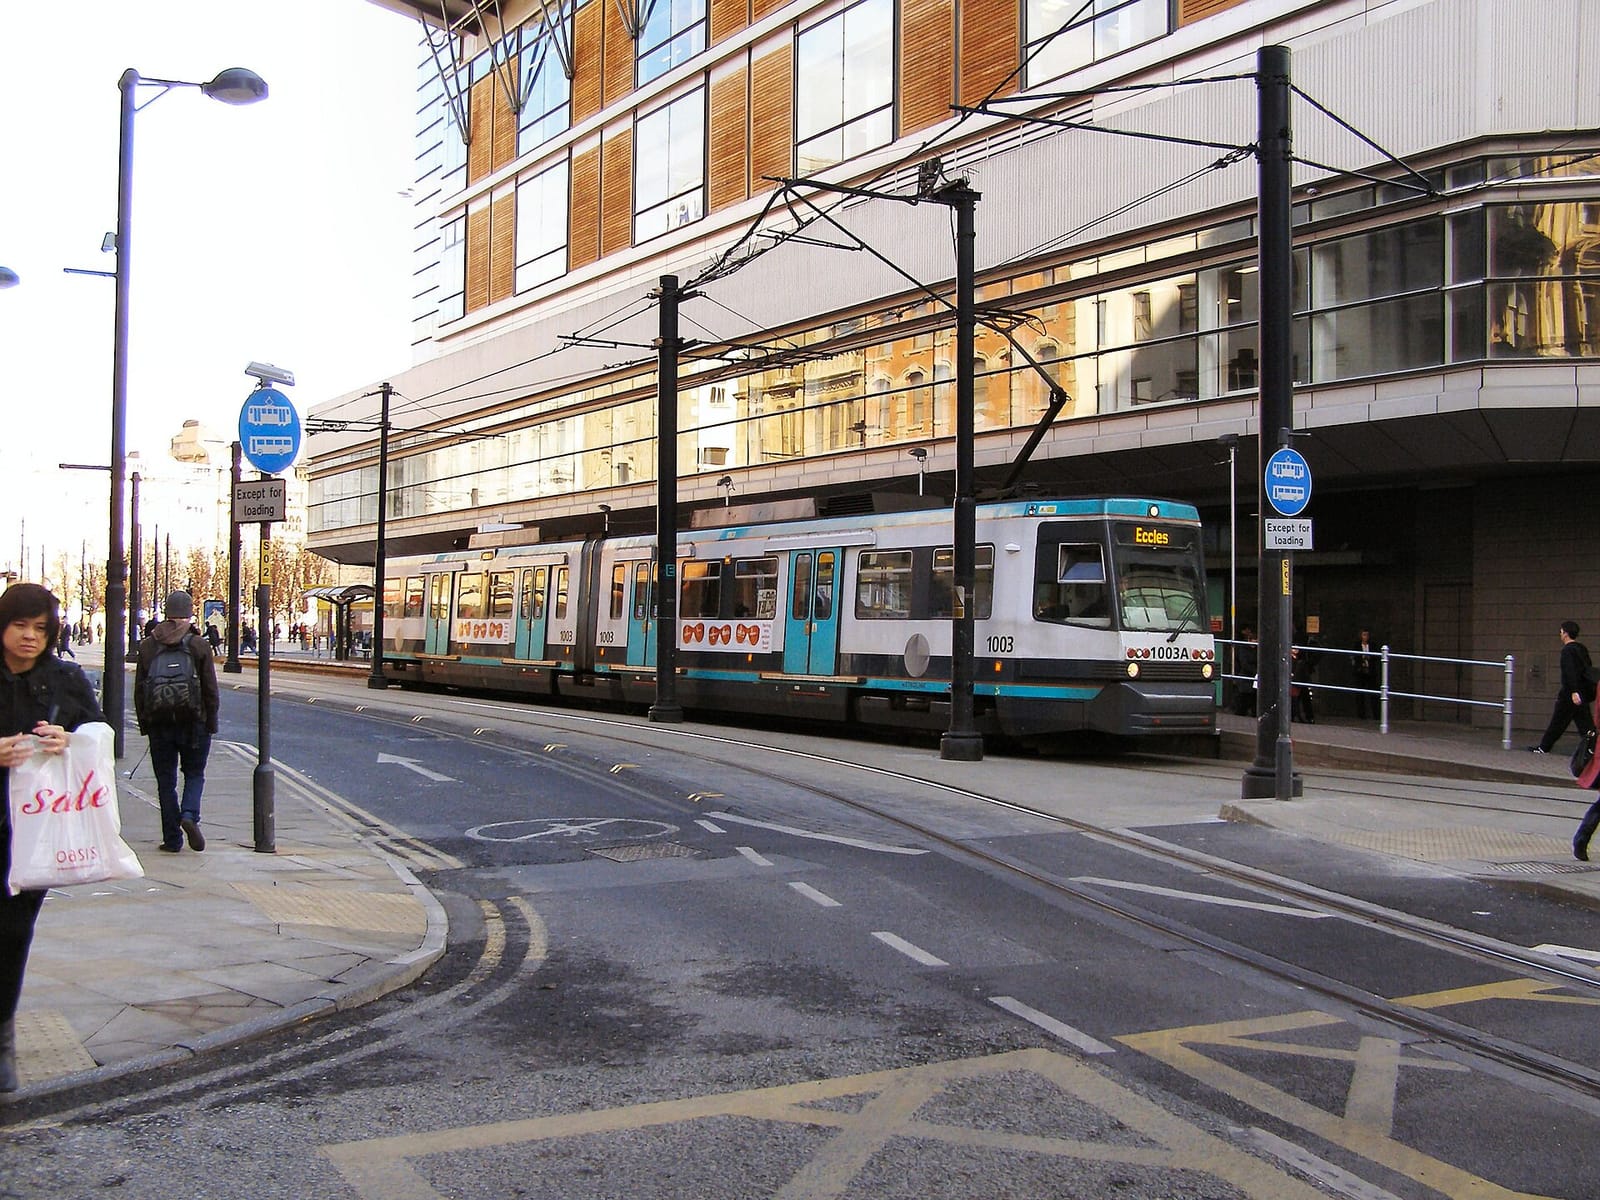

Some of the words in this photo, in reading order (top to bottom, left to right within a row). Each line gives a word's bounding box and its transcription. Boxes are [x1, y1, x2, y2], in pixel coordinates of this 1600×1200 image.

[237, 488, 266, 500] Except
[269, 487, 282, 498] for
[244, 504, 275, 516] loading
[1267, 522, 1295, 534] Except
[1298, 523, 1310, 533] for
[1135, 526, 1169, 544] Eccles
[1274, 535, 1304, 547] loading
[600, 631, 614, 643] 1003
[986, 636, 1014, 653] 1003
[1150, 646, 1190, 660] 1003A
